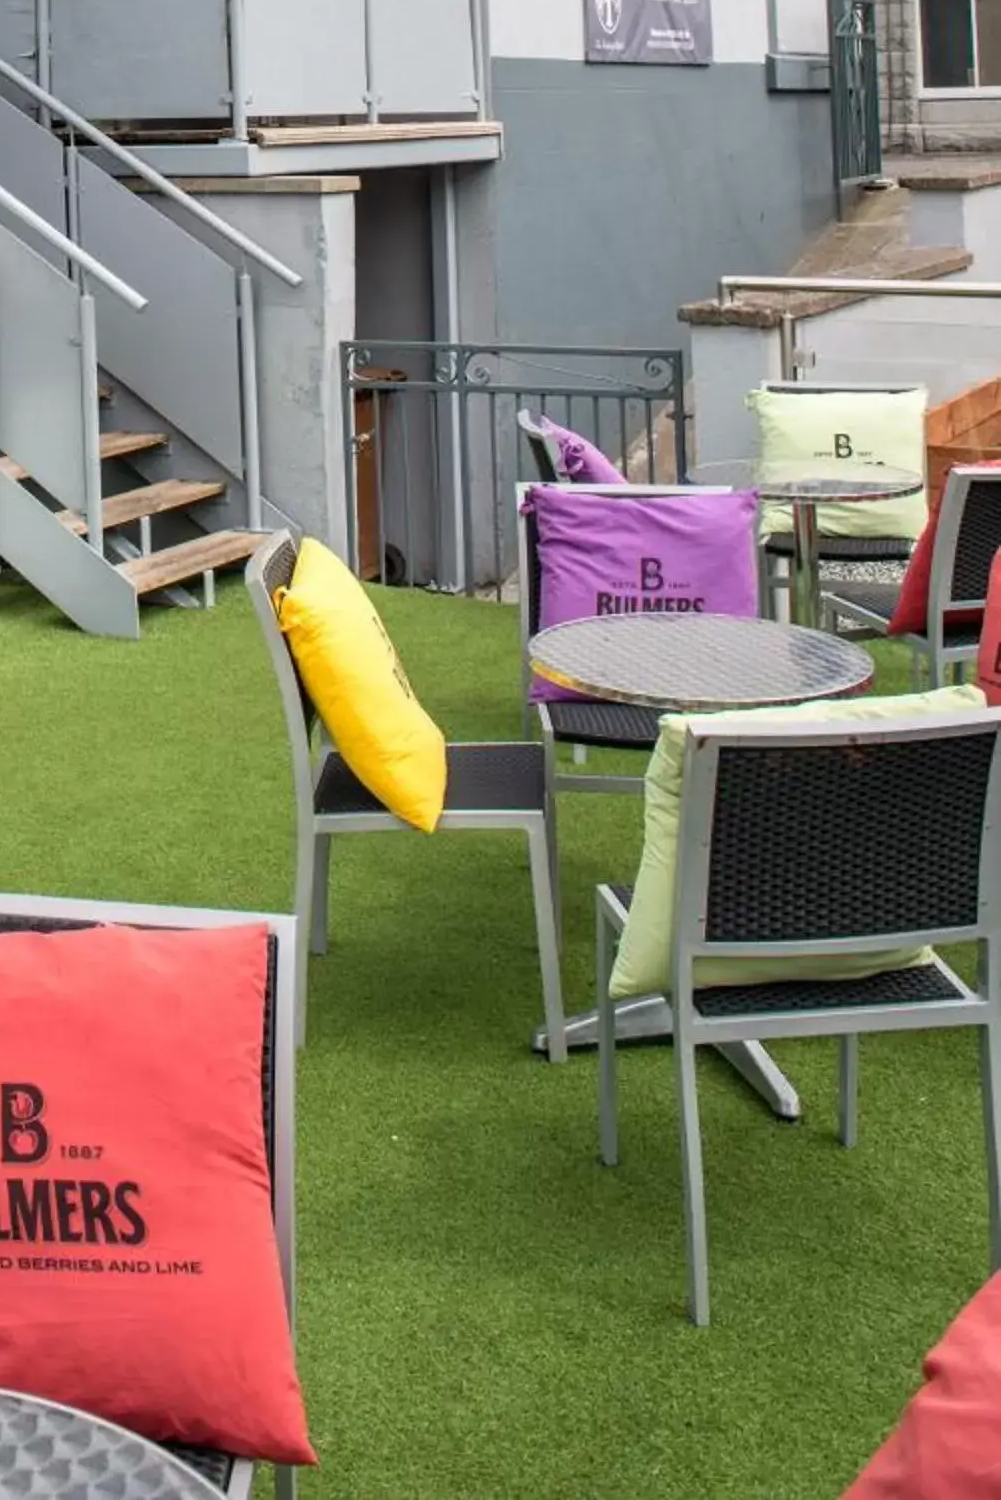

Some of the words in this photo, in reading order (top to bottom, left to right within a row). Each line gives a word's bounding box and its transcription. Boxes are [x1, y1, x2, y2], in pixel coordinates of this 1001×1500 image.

[834, 433, 853, 459] B
[640, 557, 664, 591] B
[0, 1082, 49, 1164] B
[59, 1144, 105, 1160] 1887
[18, 1256, 105, 1274] BERRIES
[108, 1259, 152, 1275] AND
[155, 1260, 204, 1276] LIME
